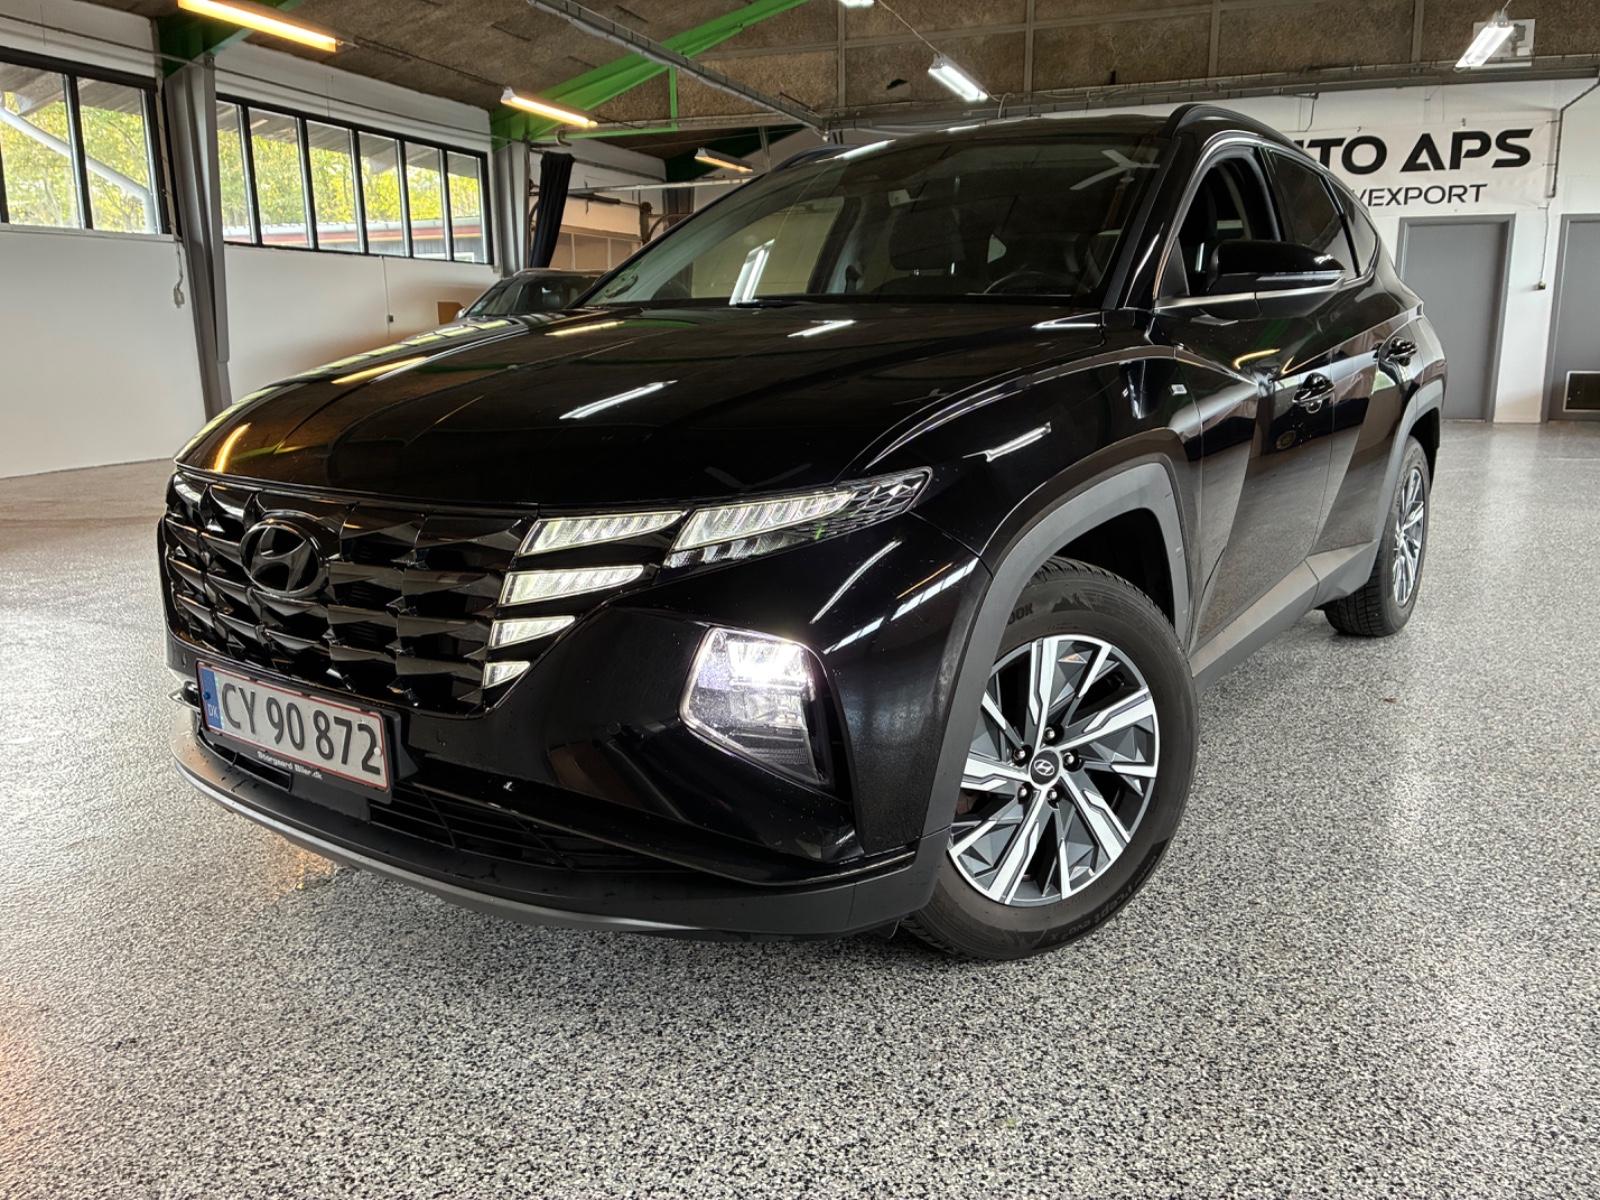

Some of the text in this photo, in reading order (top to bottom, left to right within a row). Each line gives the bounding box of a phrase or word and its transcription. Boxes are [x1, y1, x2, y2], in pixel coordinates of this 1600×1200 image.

[1294, 128, 1534, 175] TO APS
[207, 703, 220, 720] DK
[222, 682, 381, 776] CY 90 872
